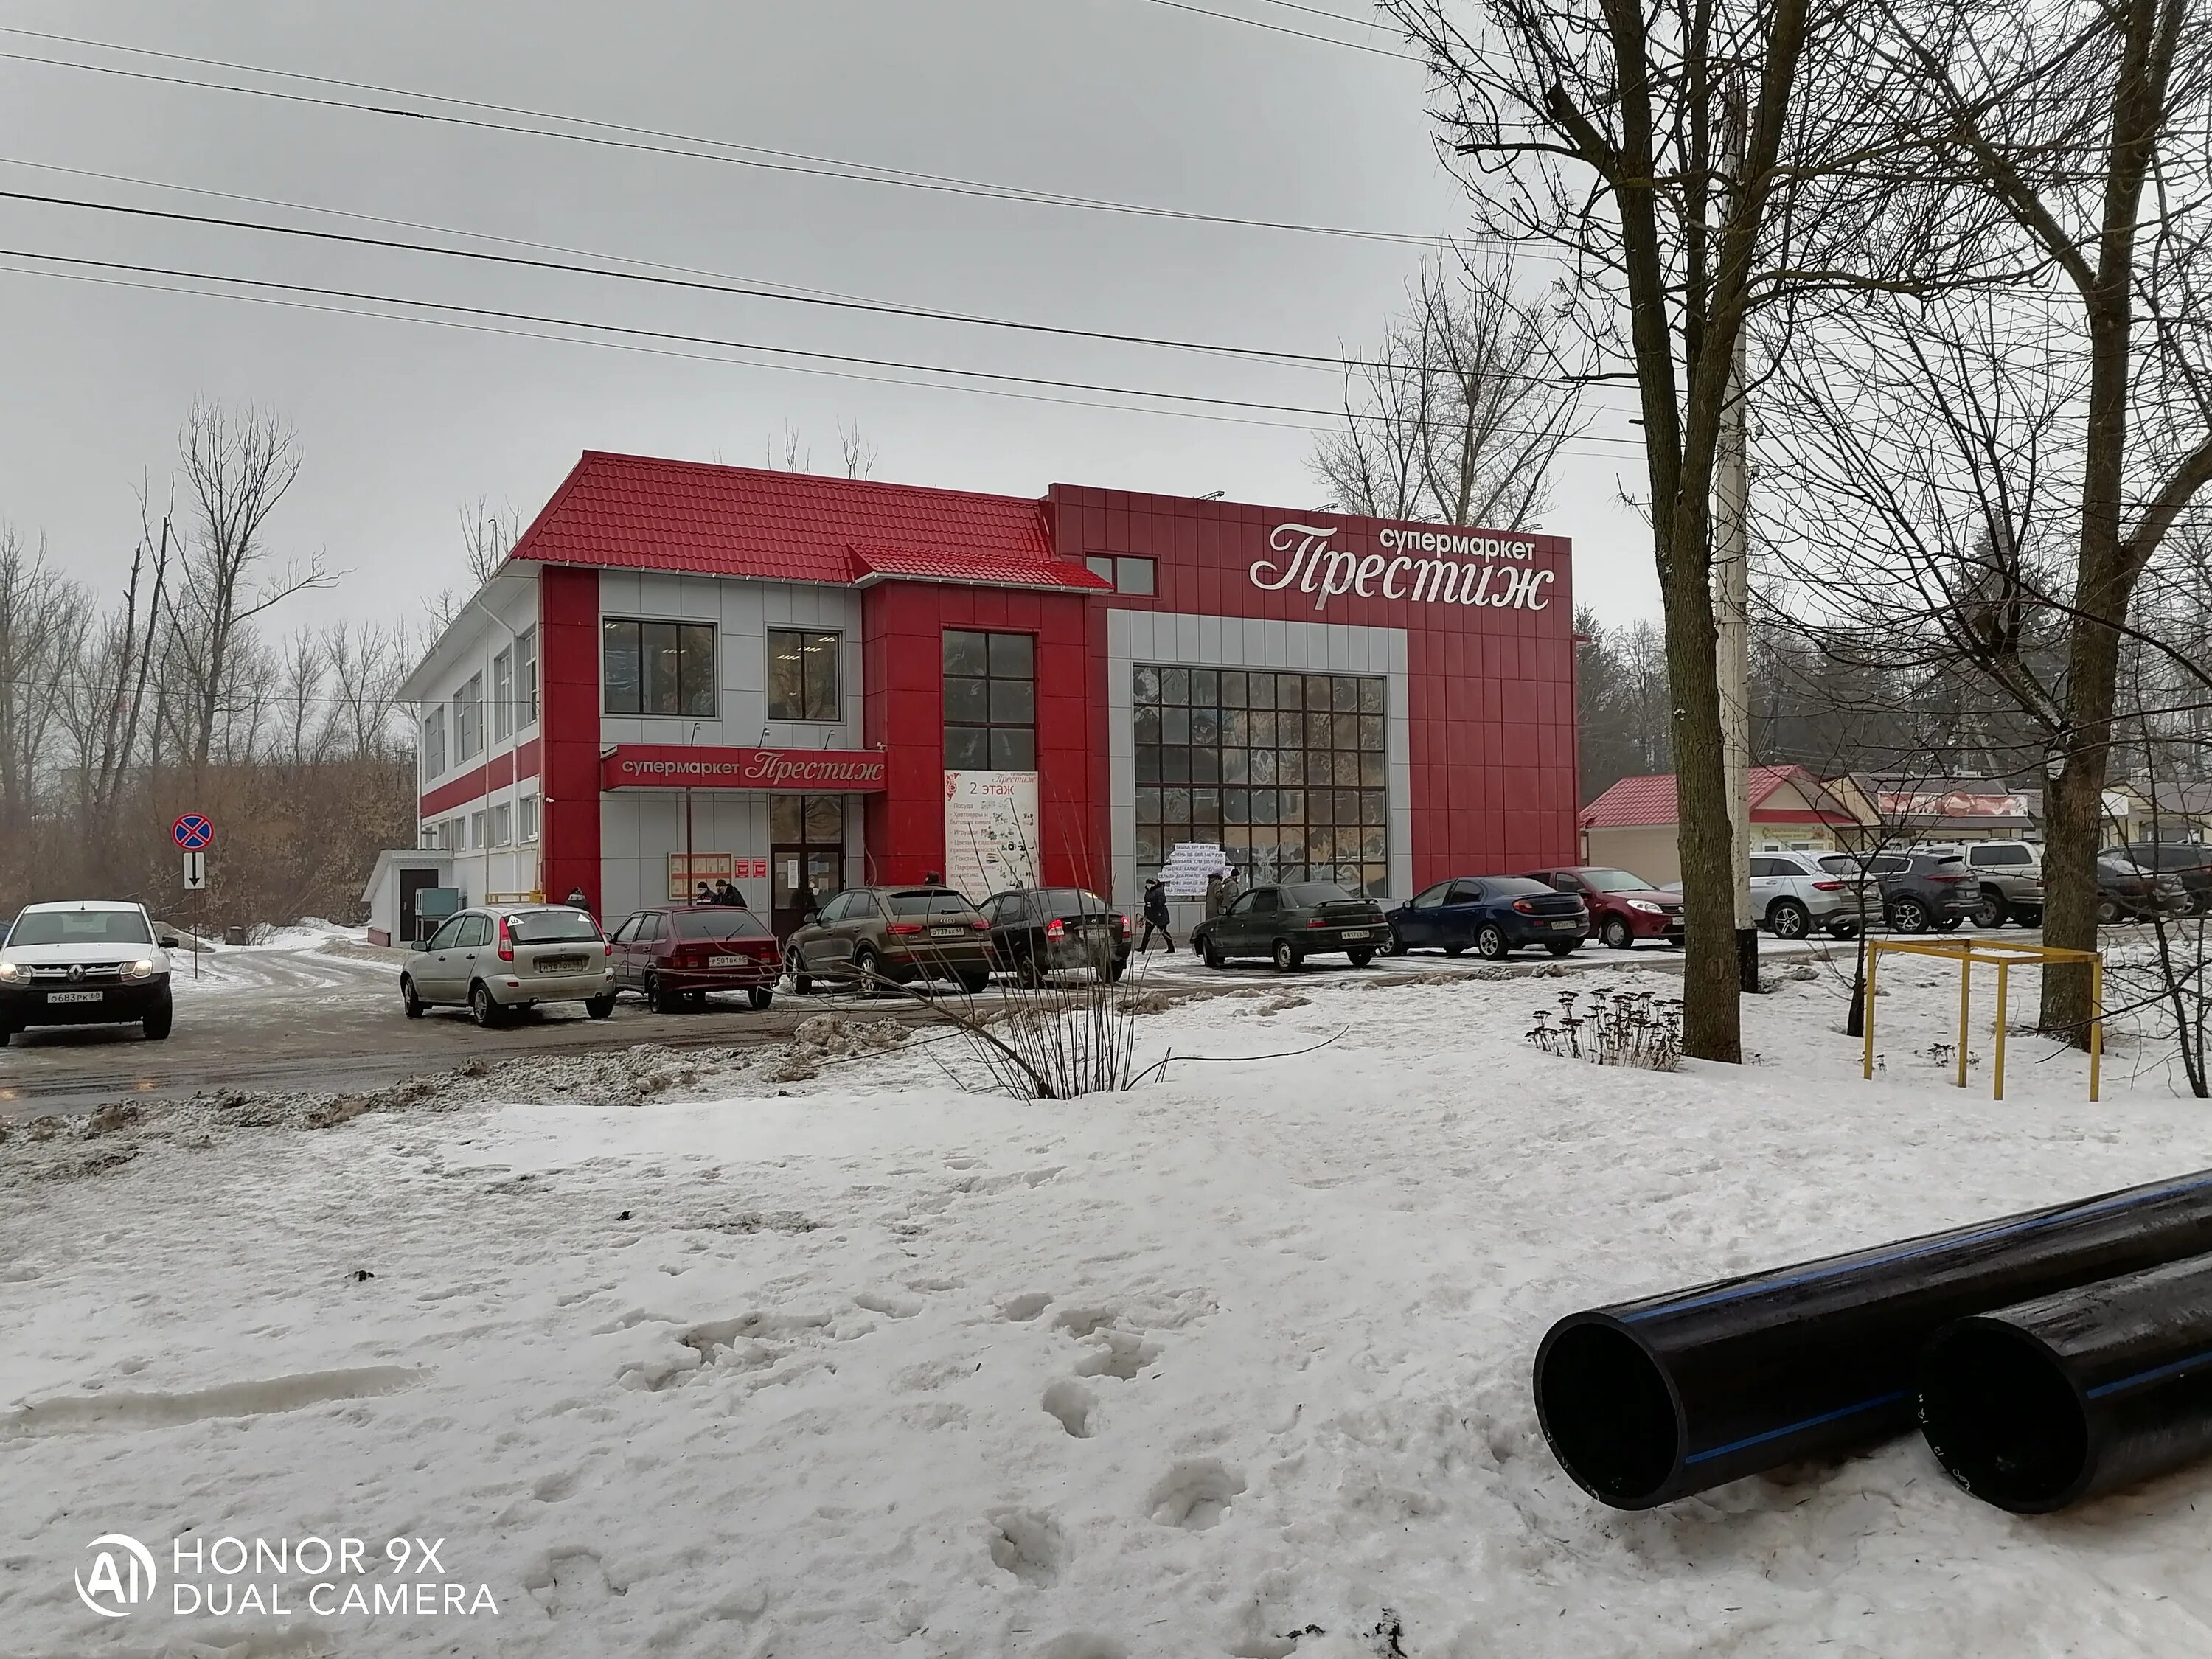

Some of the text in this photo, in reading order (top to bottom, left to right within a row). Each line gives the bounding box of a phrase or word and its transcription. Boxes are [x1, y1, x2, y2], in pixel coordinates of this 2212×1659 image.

[1380, 526, 1535, 563] супермаркет
[1249, 523, 1555, 611] Престиж
[622, 751, 885, 785] супермаркет Престиж
[992, 773, 1037, 785] Престиж
[970, 782, 1015, 796] 2 этаж
